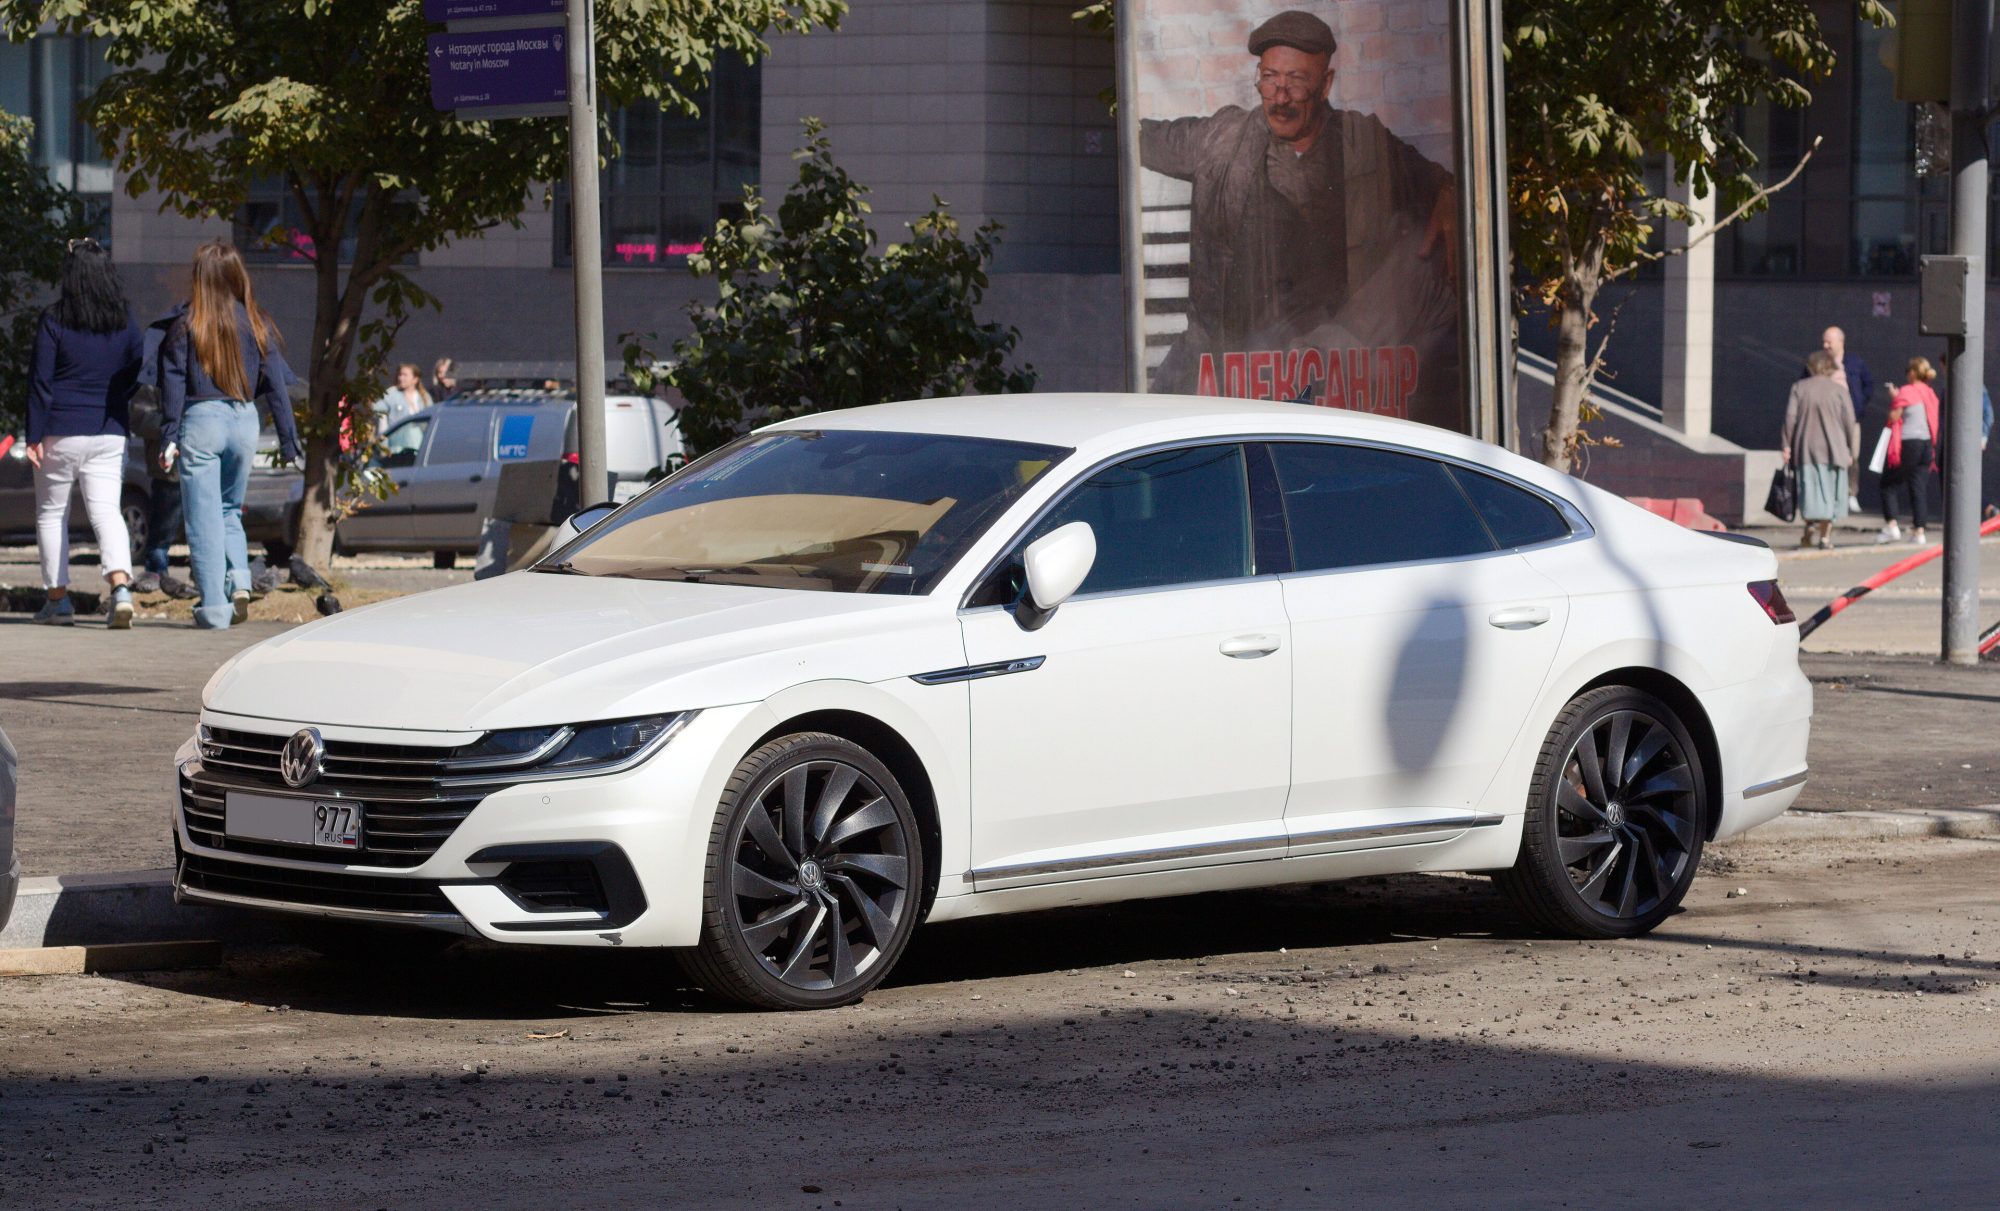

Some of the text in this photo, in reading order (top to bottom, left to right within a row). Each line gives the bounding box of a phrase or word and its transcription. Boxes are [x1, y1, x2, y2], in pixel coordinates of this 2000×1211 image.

[448, 39, 549, 57] Нотариус города Москвы
[450, 59, 510, 73] Notary in Moscow
[316, 805, 352, 833] 977
[324, 832, 342, 844] RUS
